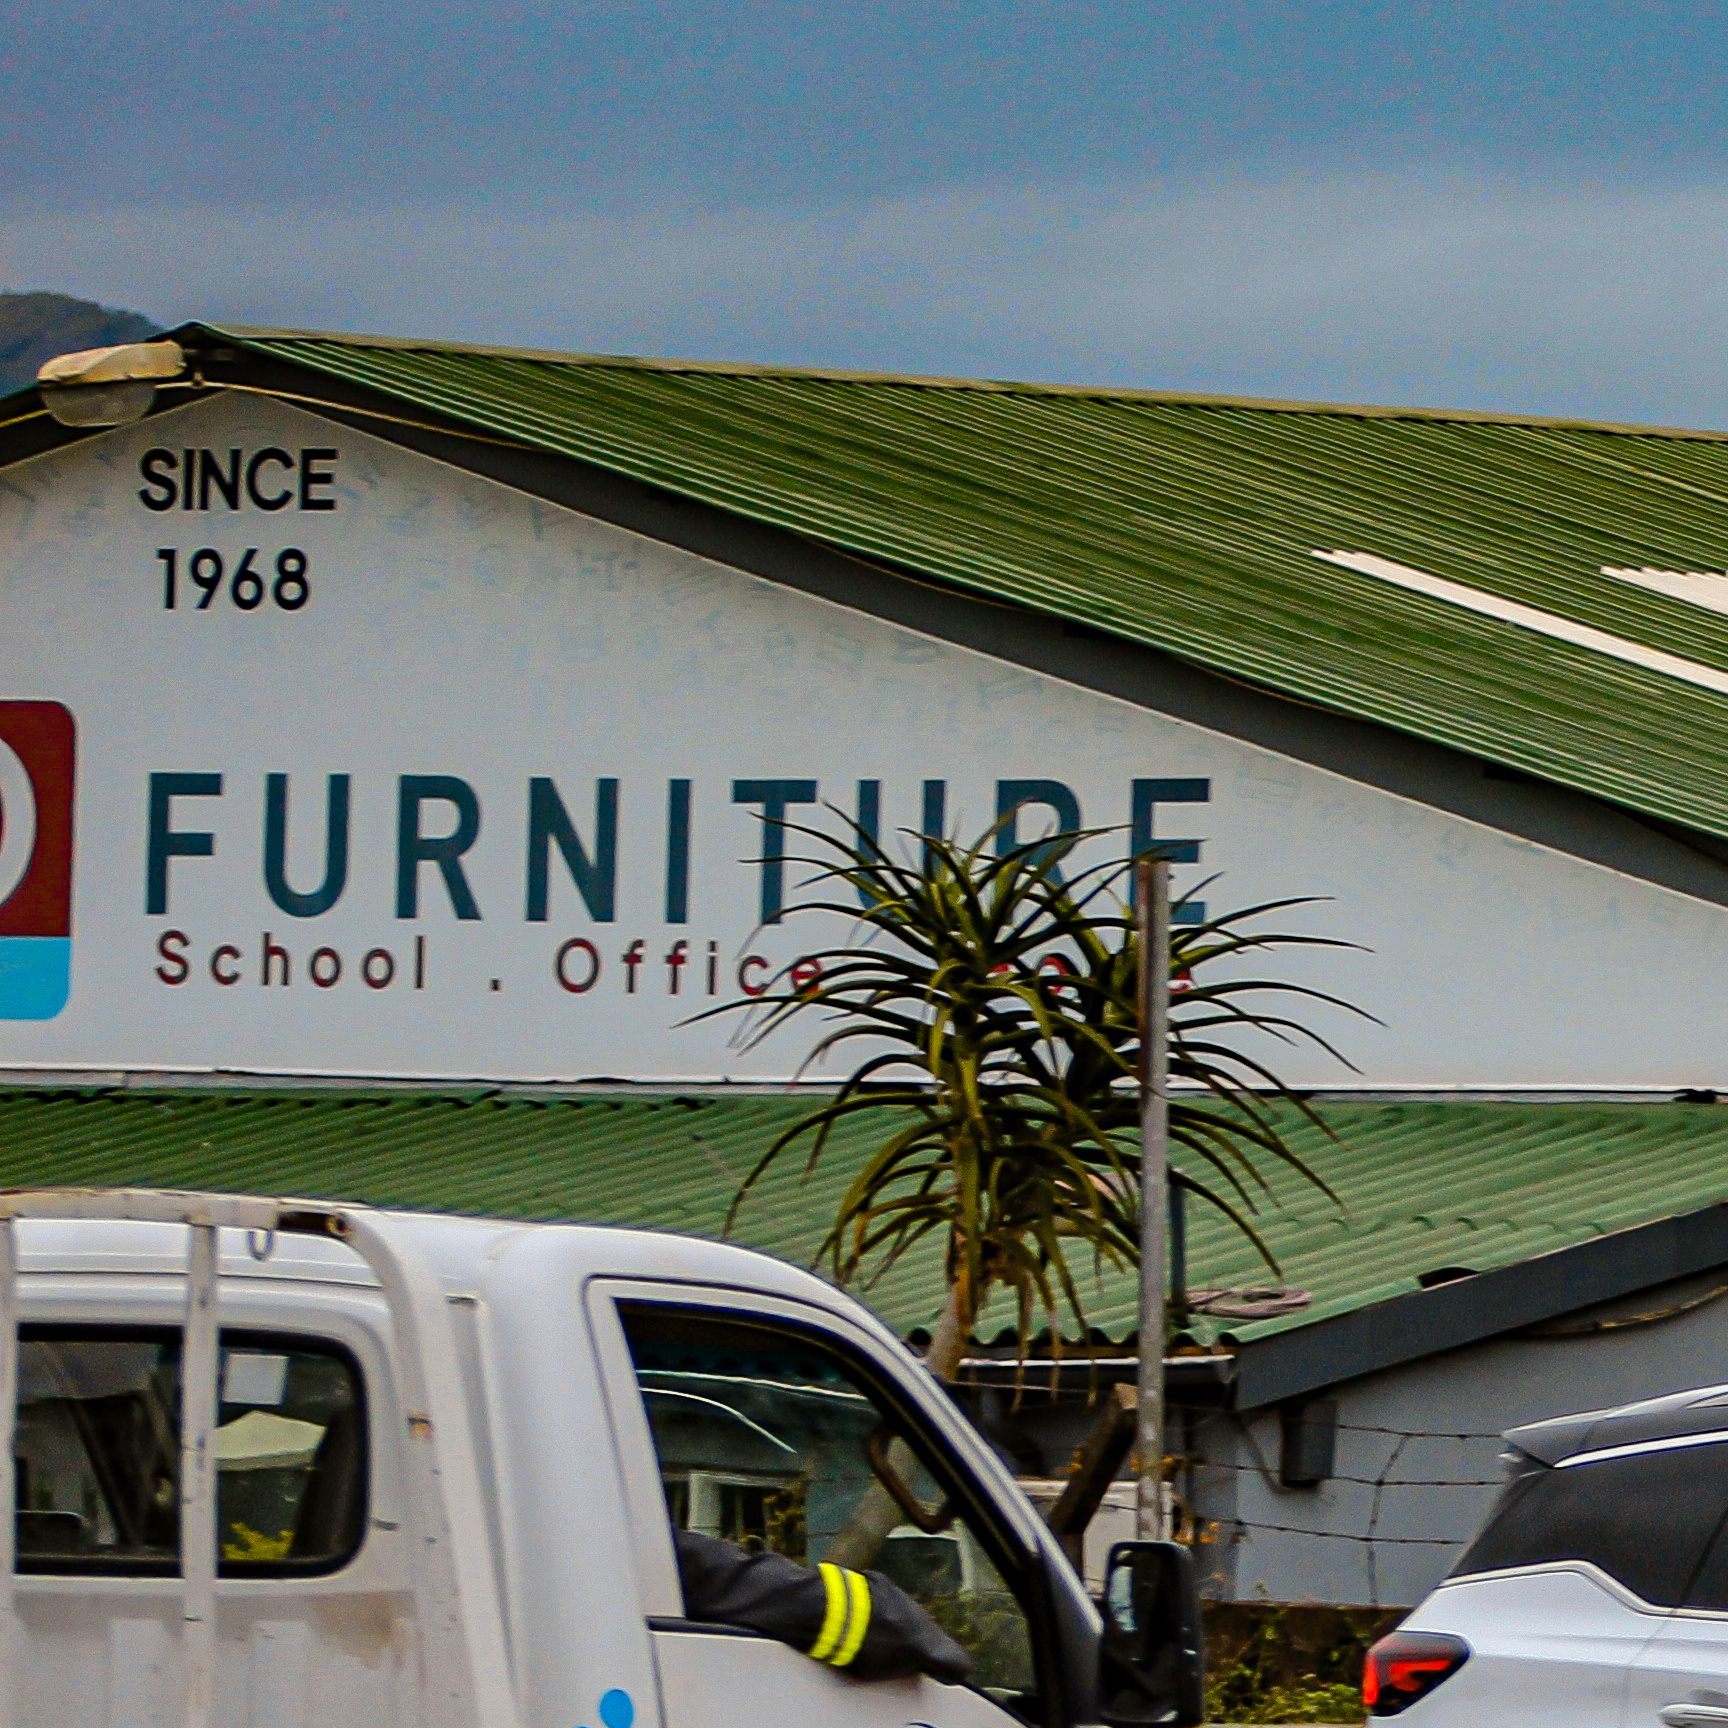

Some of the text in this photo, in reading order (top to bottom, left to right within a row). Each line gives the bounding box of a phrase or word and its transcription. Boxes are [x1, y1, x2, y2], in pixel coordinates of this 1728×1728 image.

[138, 448, 337, 514] SINCE
[158, 547, 312, 611] 1968
[144, 770, 1213, 926] FURNITURE
[155, 929, 824, 995] School Office
